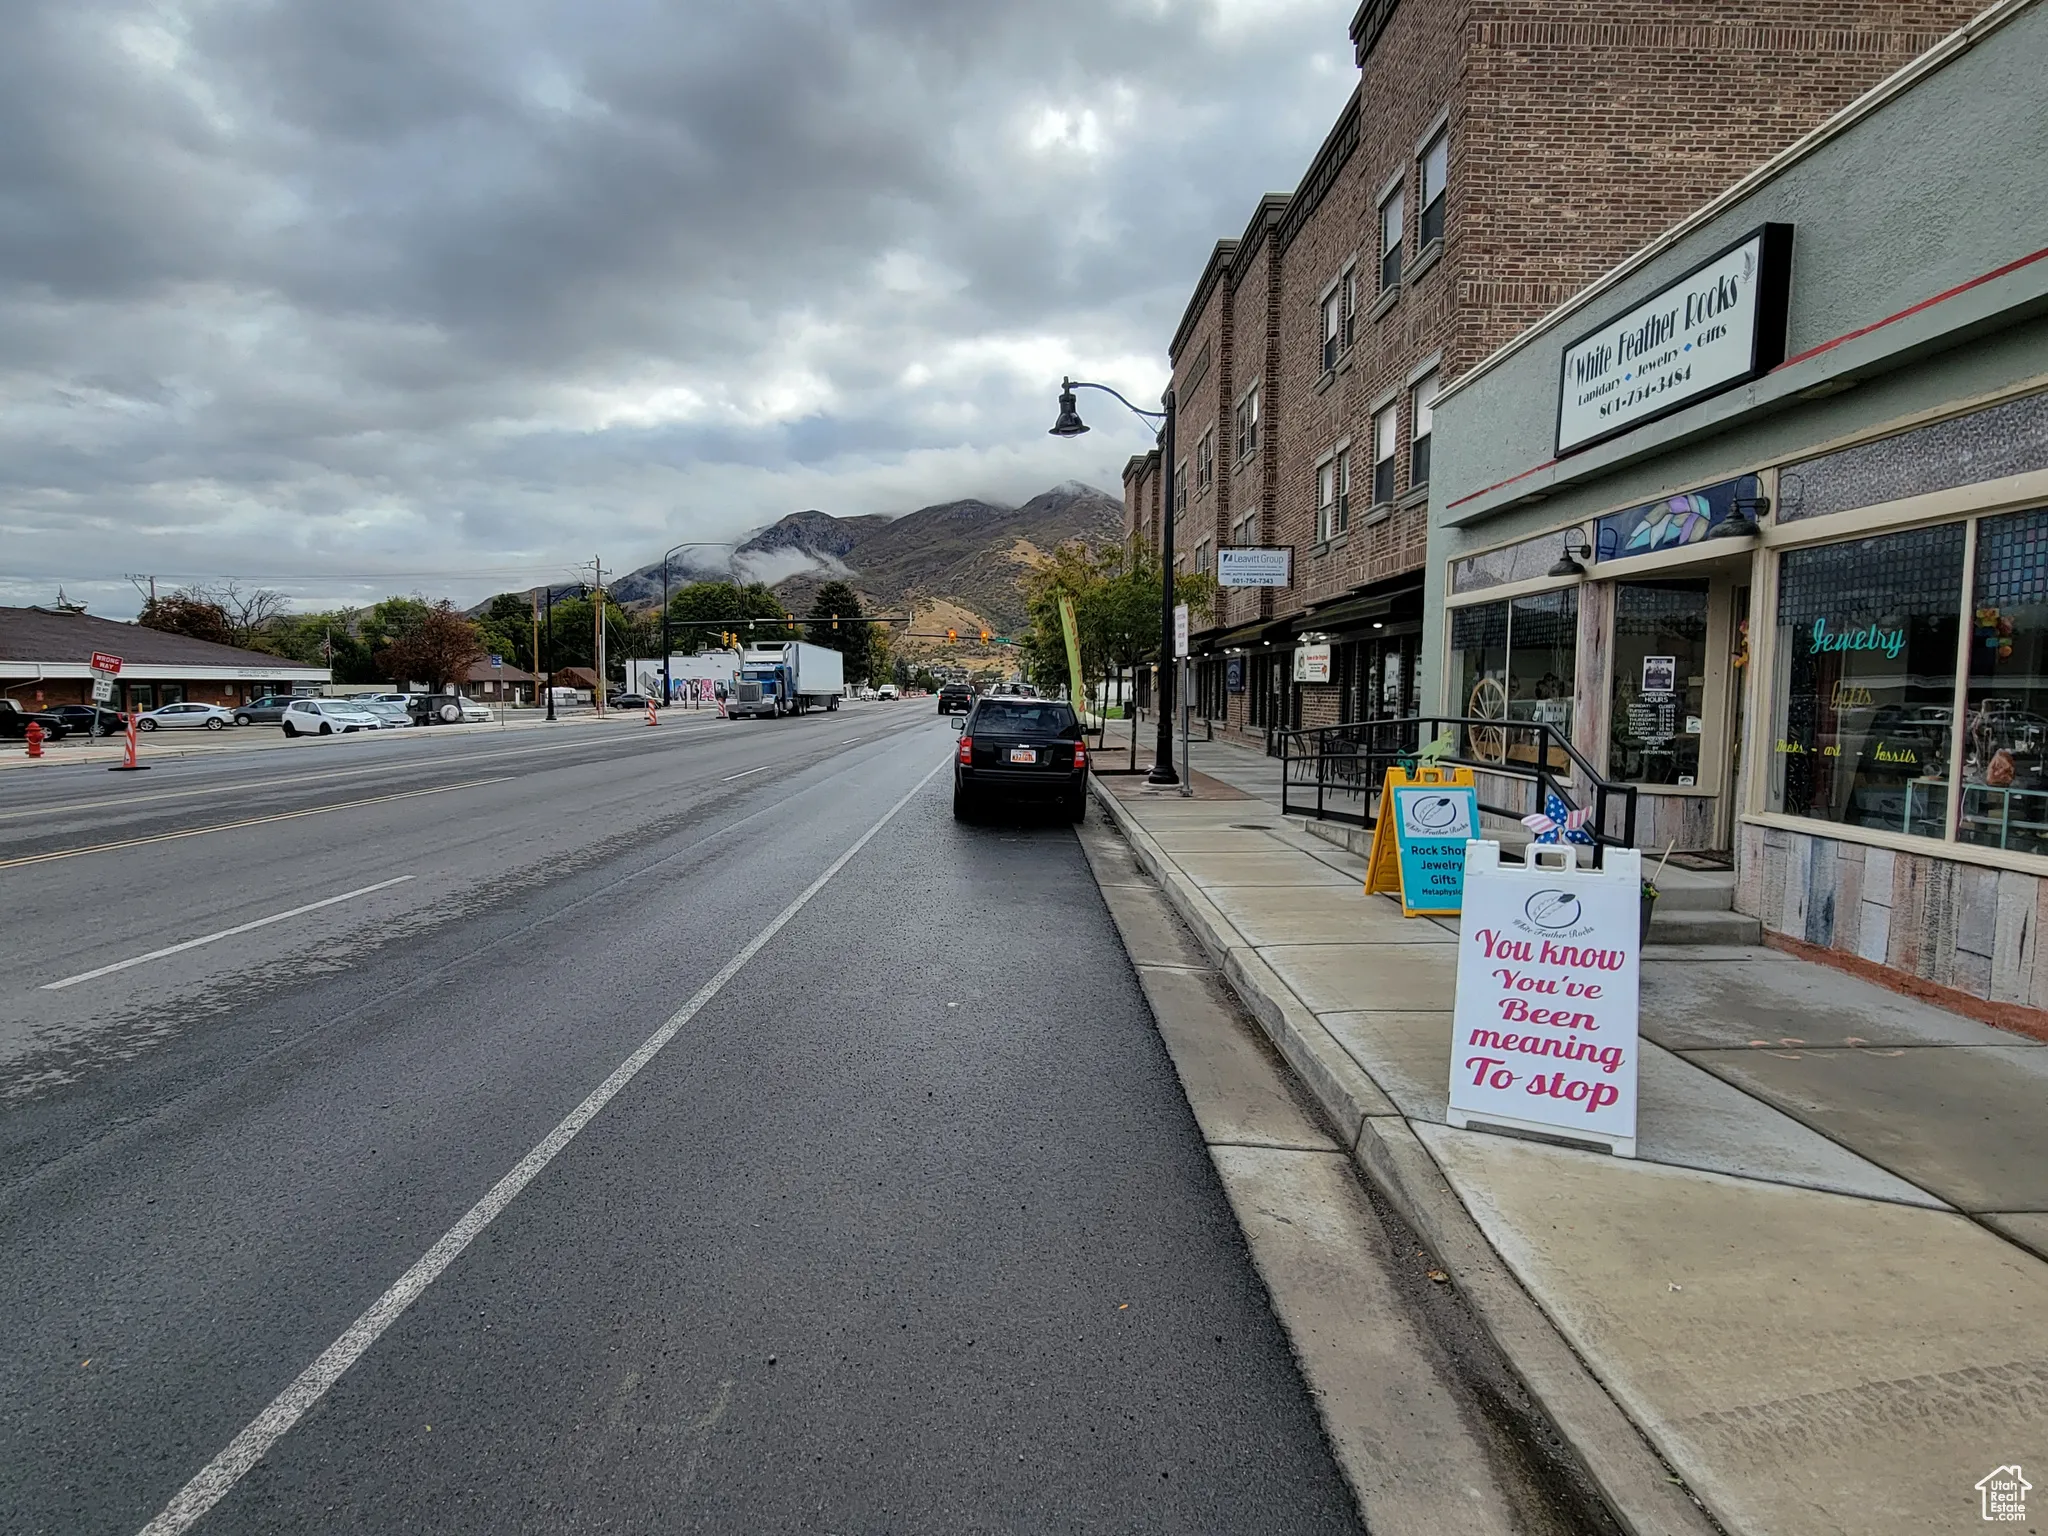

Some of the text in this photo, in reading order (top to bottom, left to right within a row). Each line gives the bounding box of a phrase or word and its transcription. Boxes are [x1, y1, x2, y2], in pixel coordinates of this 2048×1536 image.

[1576, 274, 1739, 387] White Feather Rocks
[1578, 323, 1727, 407] Lapidary Jewelry Gifts
[1599, 364, 1692, 419] 801-754-3484
[1234, 553, 1284, 565] Leavitt Group
[1810, 617, 1906, 659] Jewelry
[96, 654, 120, 665] WRONG
[99, 662, 114, 670] WAY
[1411, 845, 1438, 856] Rock
[1421, 860, 1463, 872] Jewelry
[1431, 874, 1457, 885] Gifts
[1534, 928, 1567, 939] Feather
[1569, 926, 1595, 938] Rocks
[1475, 929, 1625, 971] You know
[1492, 968, 1603, 999] You've
[1498, 998, 1600, 1031] Been
[1469, 1028, 1626, 1073] meaning
[1465, 1057, 1619, 1113] To stop
